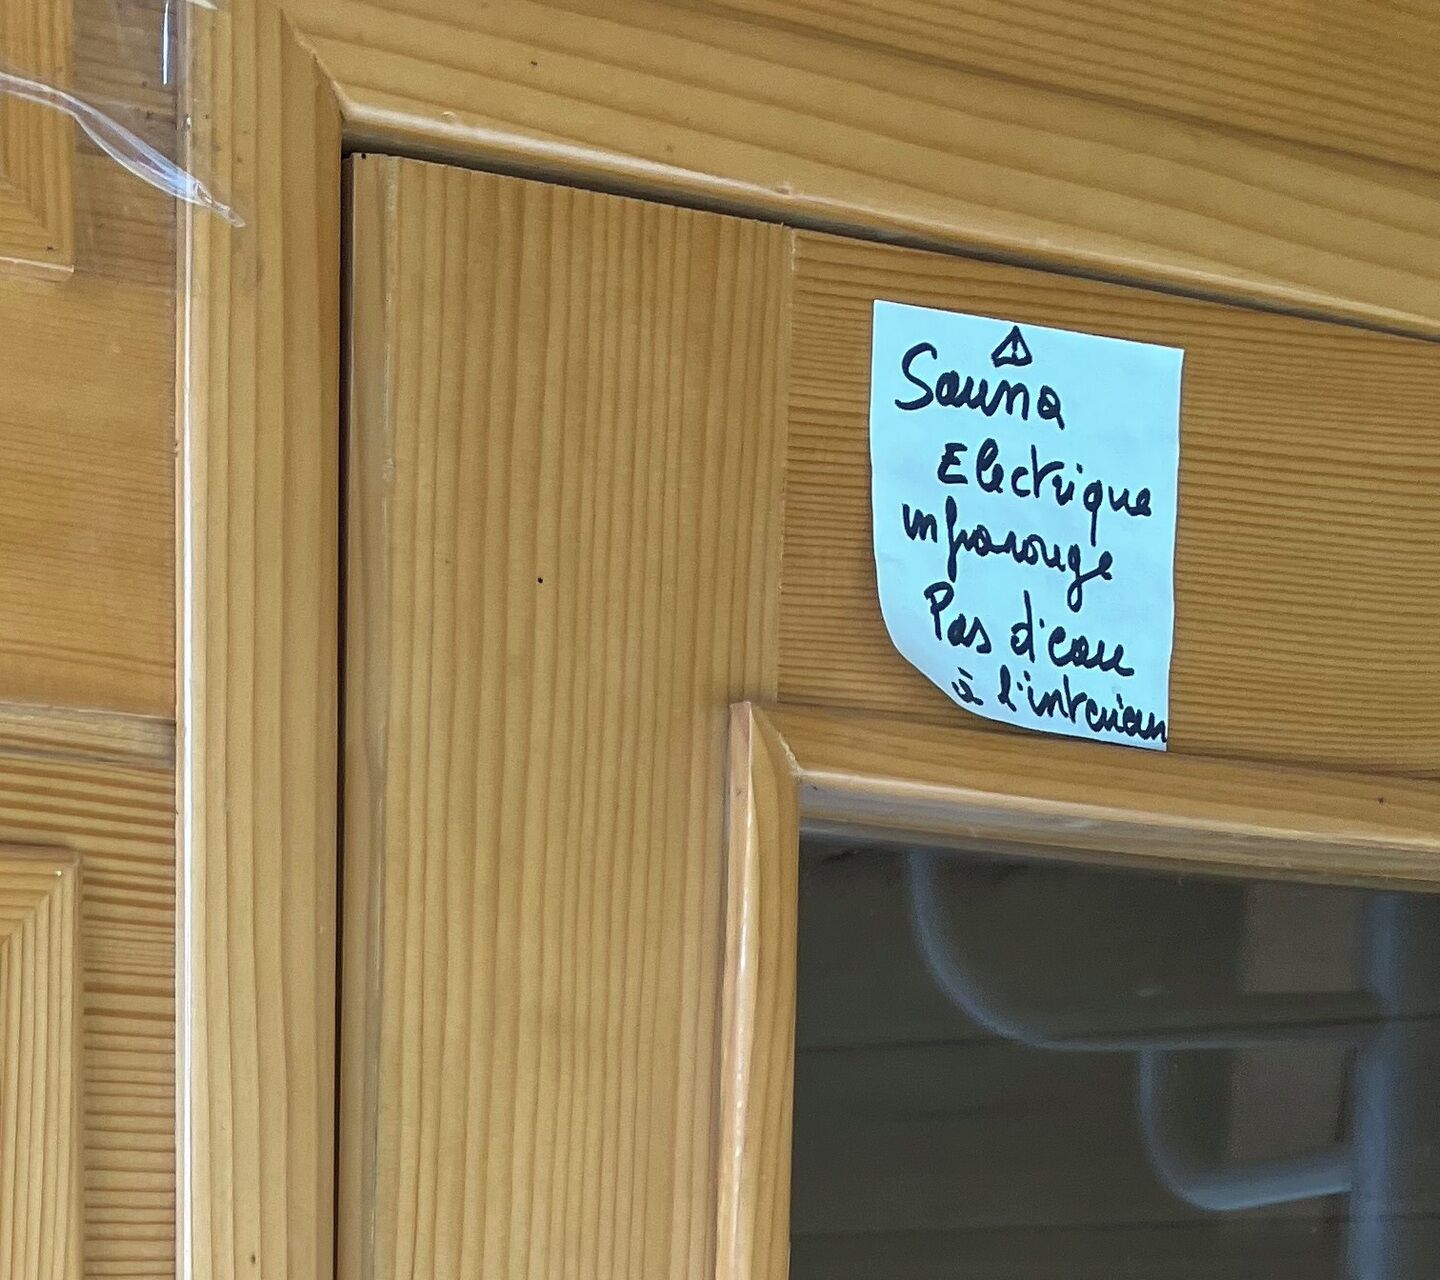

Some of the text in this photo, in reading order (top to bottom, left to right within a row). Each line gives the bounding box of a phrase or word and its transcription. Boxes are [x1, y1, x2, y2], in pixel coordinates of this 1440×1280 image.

[895, 342, 1066, 431] Sauna
[937, 438, 1152, 546] Electrique
[923, 581, 992, 654] Pas
[1011, 590, 1134, 676] d'eau
